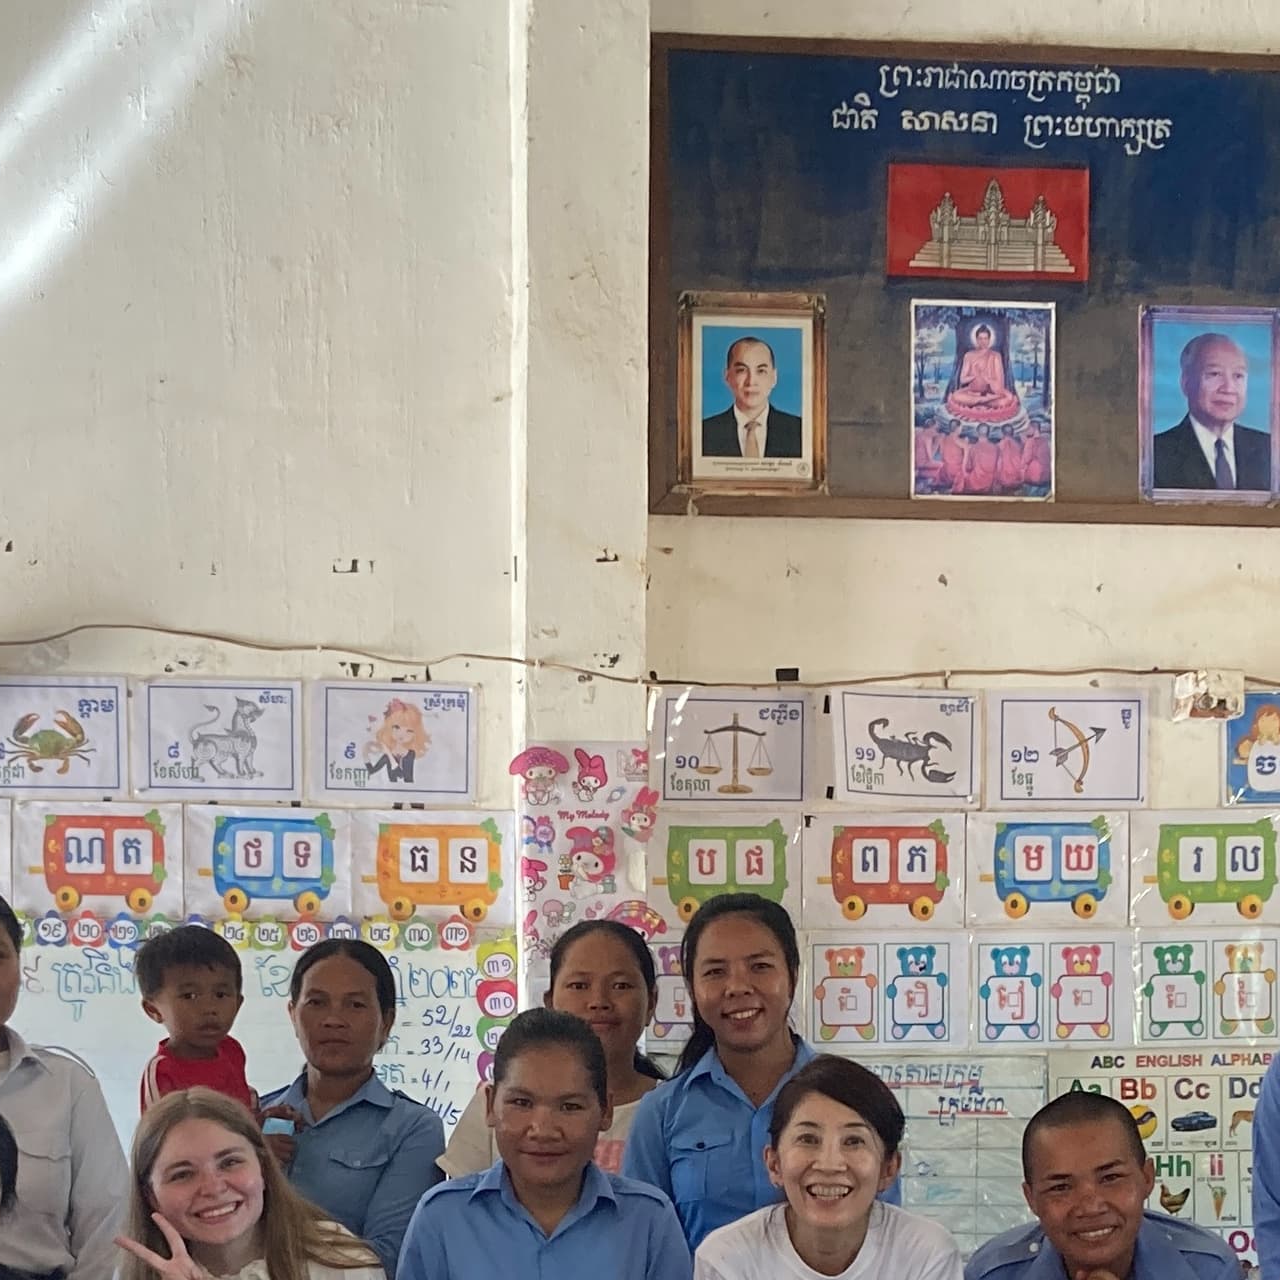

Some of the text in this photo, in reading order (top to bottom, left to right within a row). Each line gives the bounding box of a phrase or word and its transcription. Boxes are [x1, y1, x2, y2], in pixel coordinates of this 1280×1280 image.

[879, 63, 1121, 111] ព្រះរាជាណាចក្រកម្ពុជា
[832, 93, 1172, 155] ជាតិ សាសនា ព្រះមហាក្សត្រ
[168, 742, 179, 758] ៨
[855, 747, 875, 761] ១១
[1011, 747, 1039, 763] ១២
[676, 756, 701, 770] ១០
[65, 836, 141, 864] ណ ត
[243, 838, 312, 868] ថ ទ
[410, 845, 478, 873] ធ ន
[697, 845, 763, 875] ប ផ
[862, 845, 927, 872] ព ភ
[1023, 844, 1095, 872] ម យ
[1194, 845, 1262, 872] រ ល
[487, 959, 511, 973] ៣១
[490, 996, 513, 1010] ៣០
[1091, 1053, 1273, 1069] ABC ENGLISH ALPHAB
[1120, 1077, 1157, 1100] Bb
[1174, 1077, 1210, 1100] Cc
[1155, 1154, 1192, 1177] Hh
